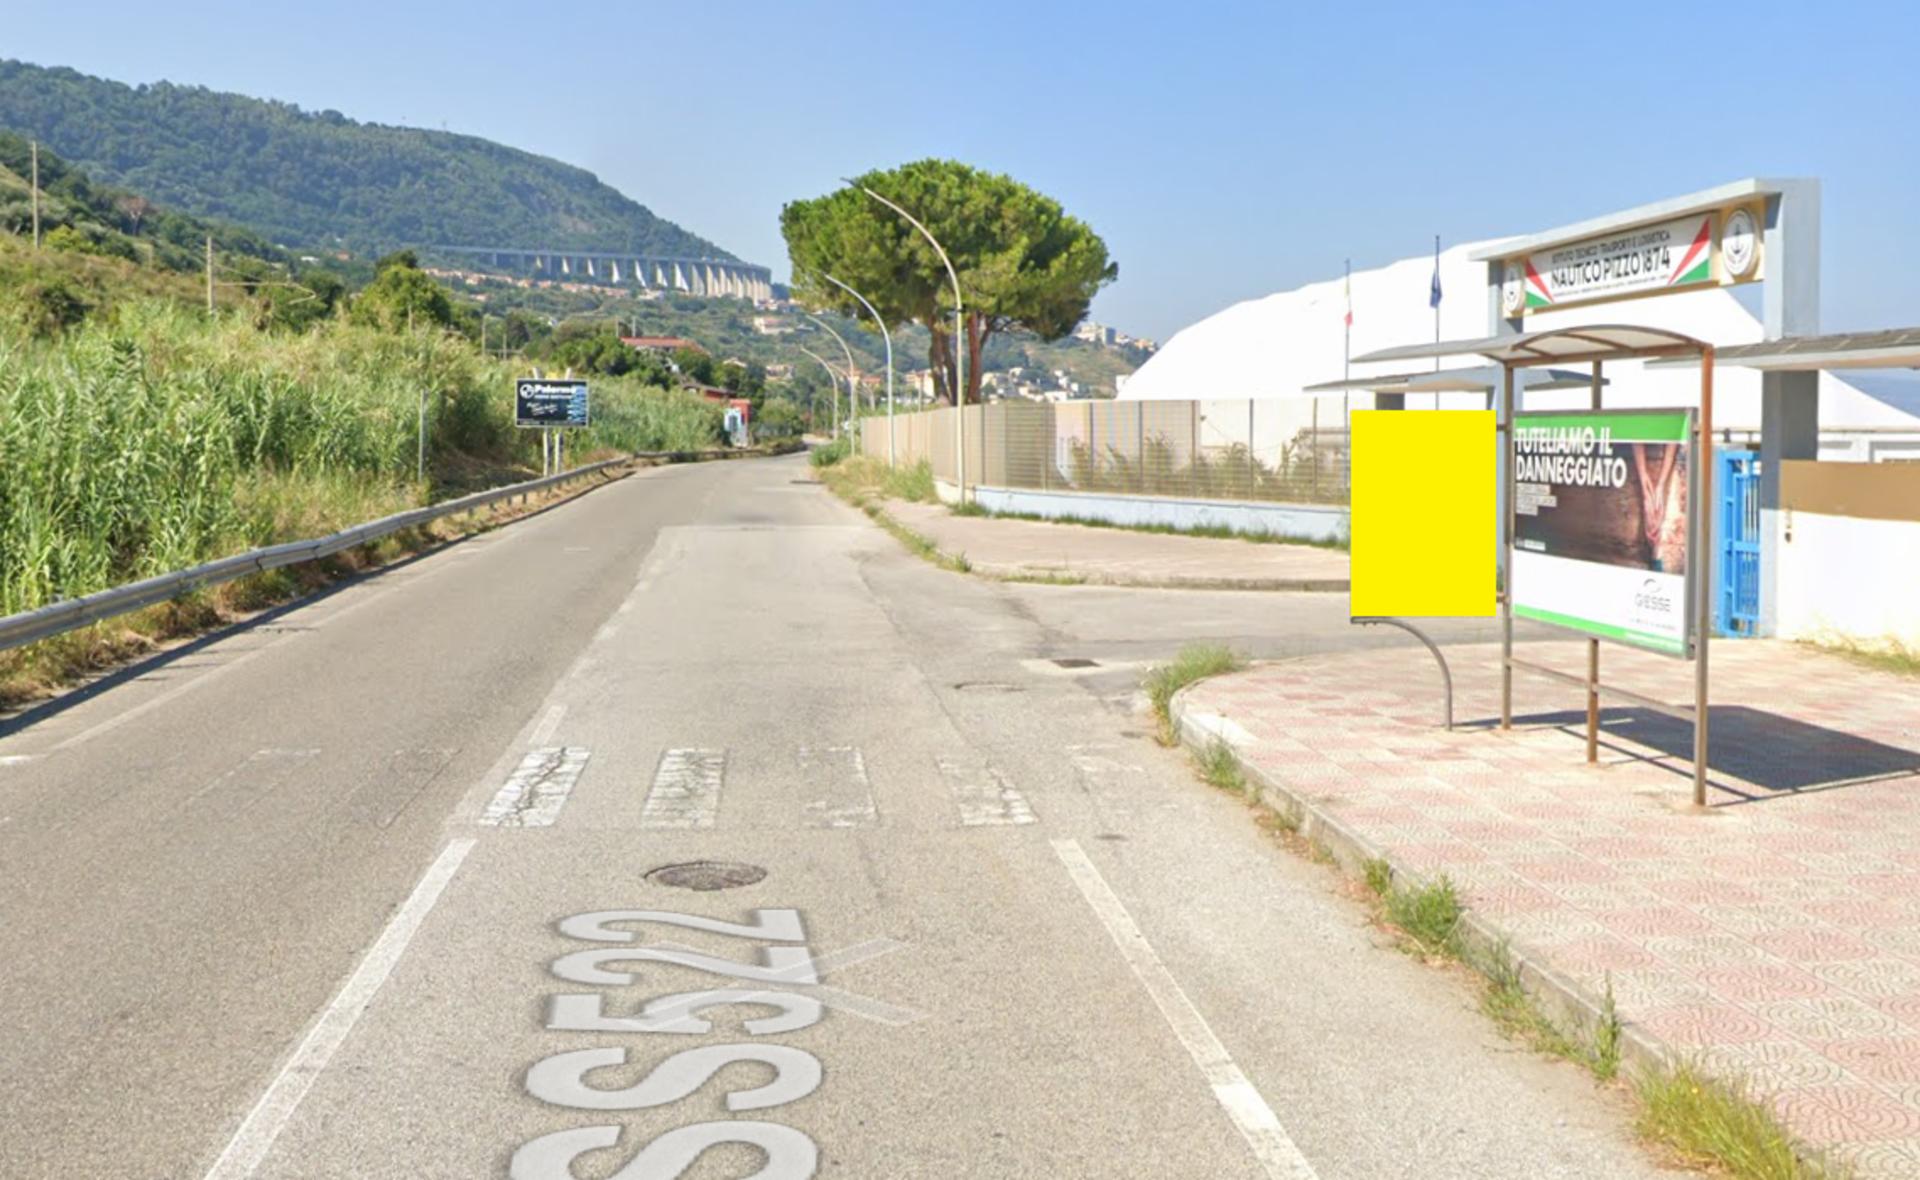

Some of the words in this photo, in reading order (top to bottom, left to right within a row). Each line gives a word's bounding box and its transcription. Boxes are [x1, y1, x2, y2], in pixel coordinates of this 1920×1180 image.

[1551, 258, 1602, 288] NAUTICO
[1602, 250, 1641, 281] PIZZO
[1641, 244, 1671, 275] 1874
[1515, 425, 1595, 455] TUTELIAMO
[1598, 426, 1614, 456] IL
[1516, 455, 1627, 488] DANNEGGIATO
